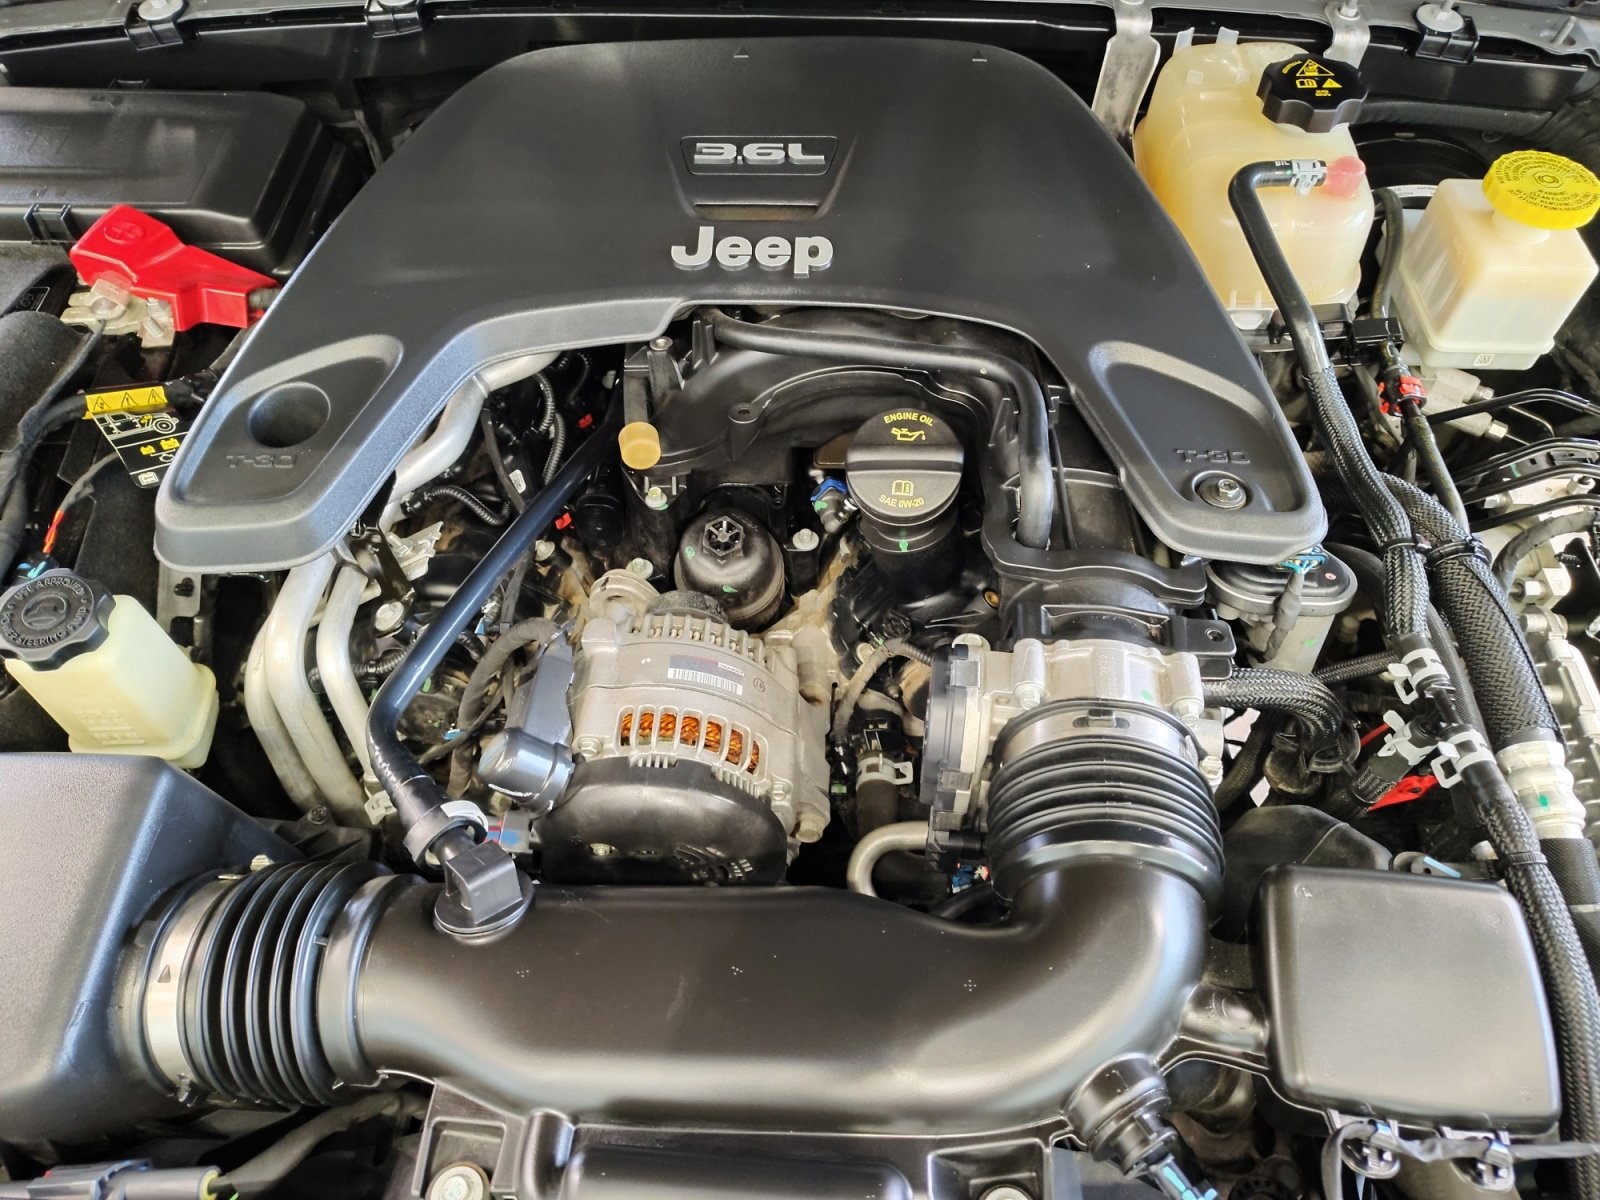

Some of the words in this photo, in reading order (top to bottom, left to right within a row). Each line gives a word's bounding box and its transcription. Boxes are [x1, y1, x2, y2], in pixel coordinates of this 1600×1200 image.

[693, 142, 826, 165] 3.6L
[670, 226, 834, 279] Jeep
[883, 412, 919, 424] ENGINE
[919, 414, 934, 427] OIL
[879, 494, 898, 508] SAE
[898, 497, 925, 508] 0W-20
[15, 586, 34, 600] USE
[36, 577, 85, 597] APPROVED
[18, 630, 67, 647] STEERING
